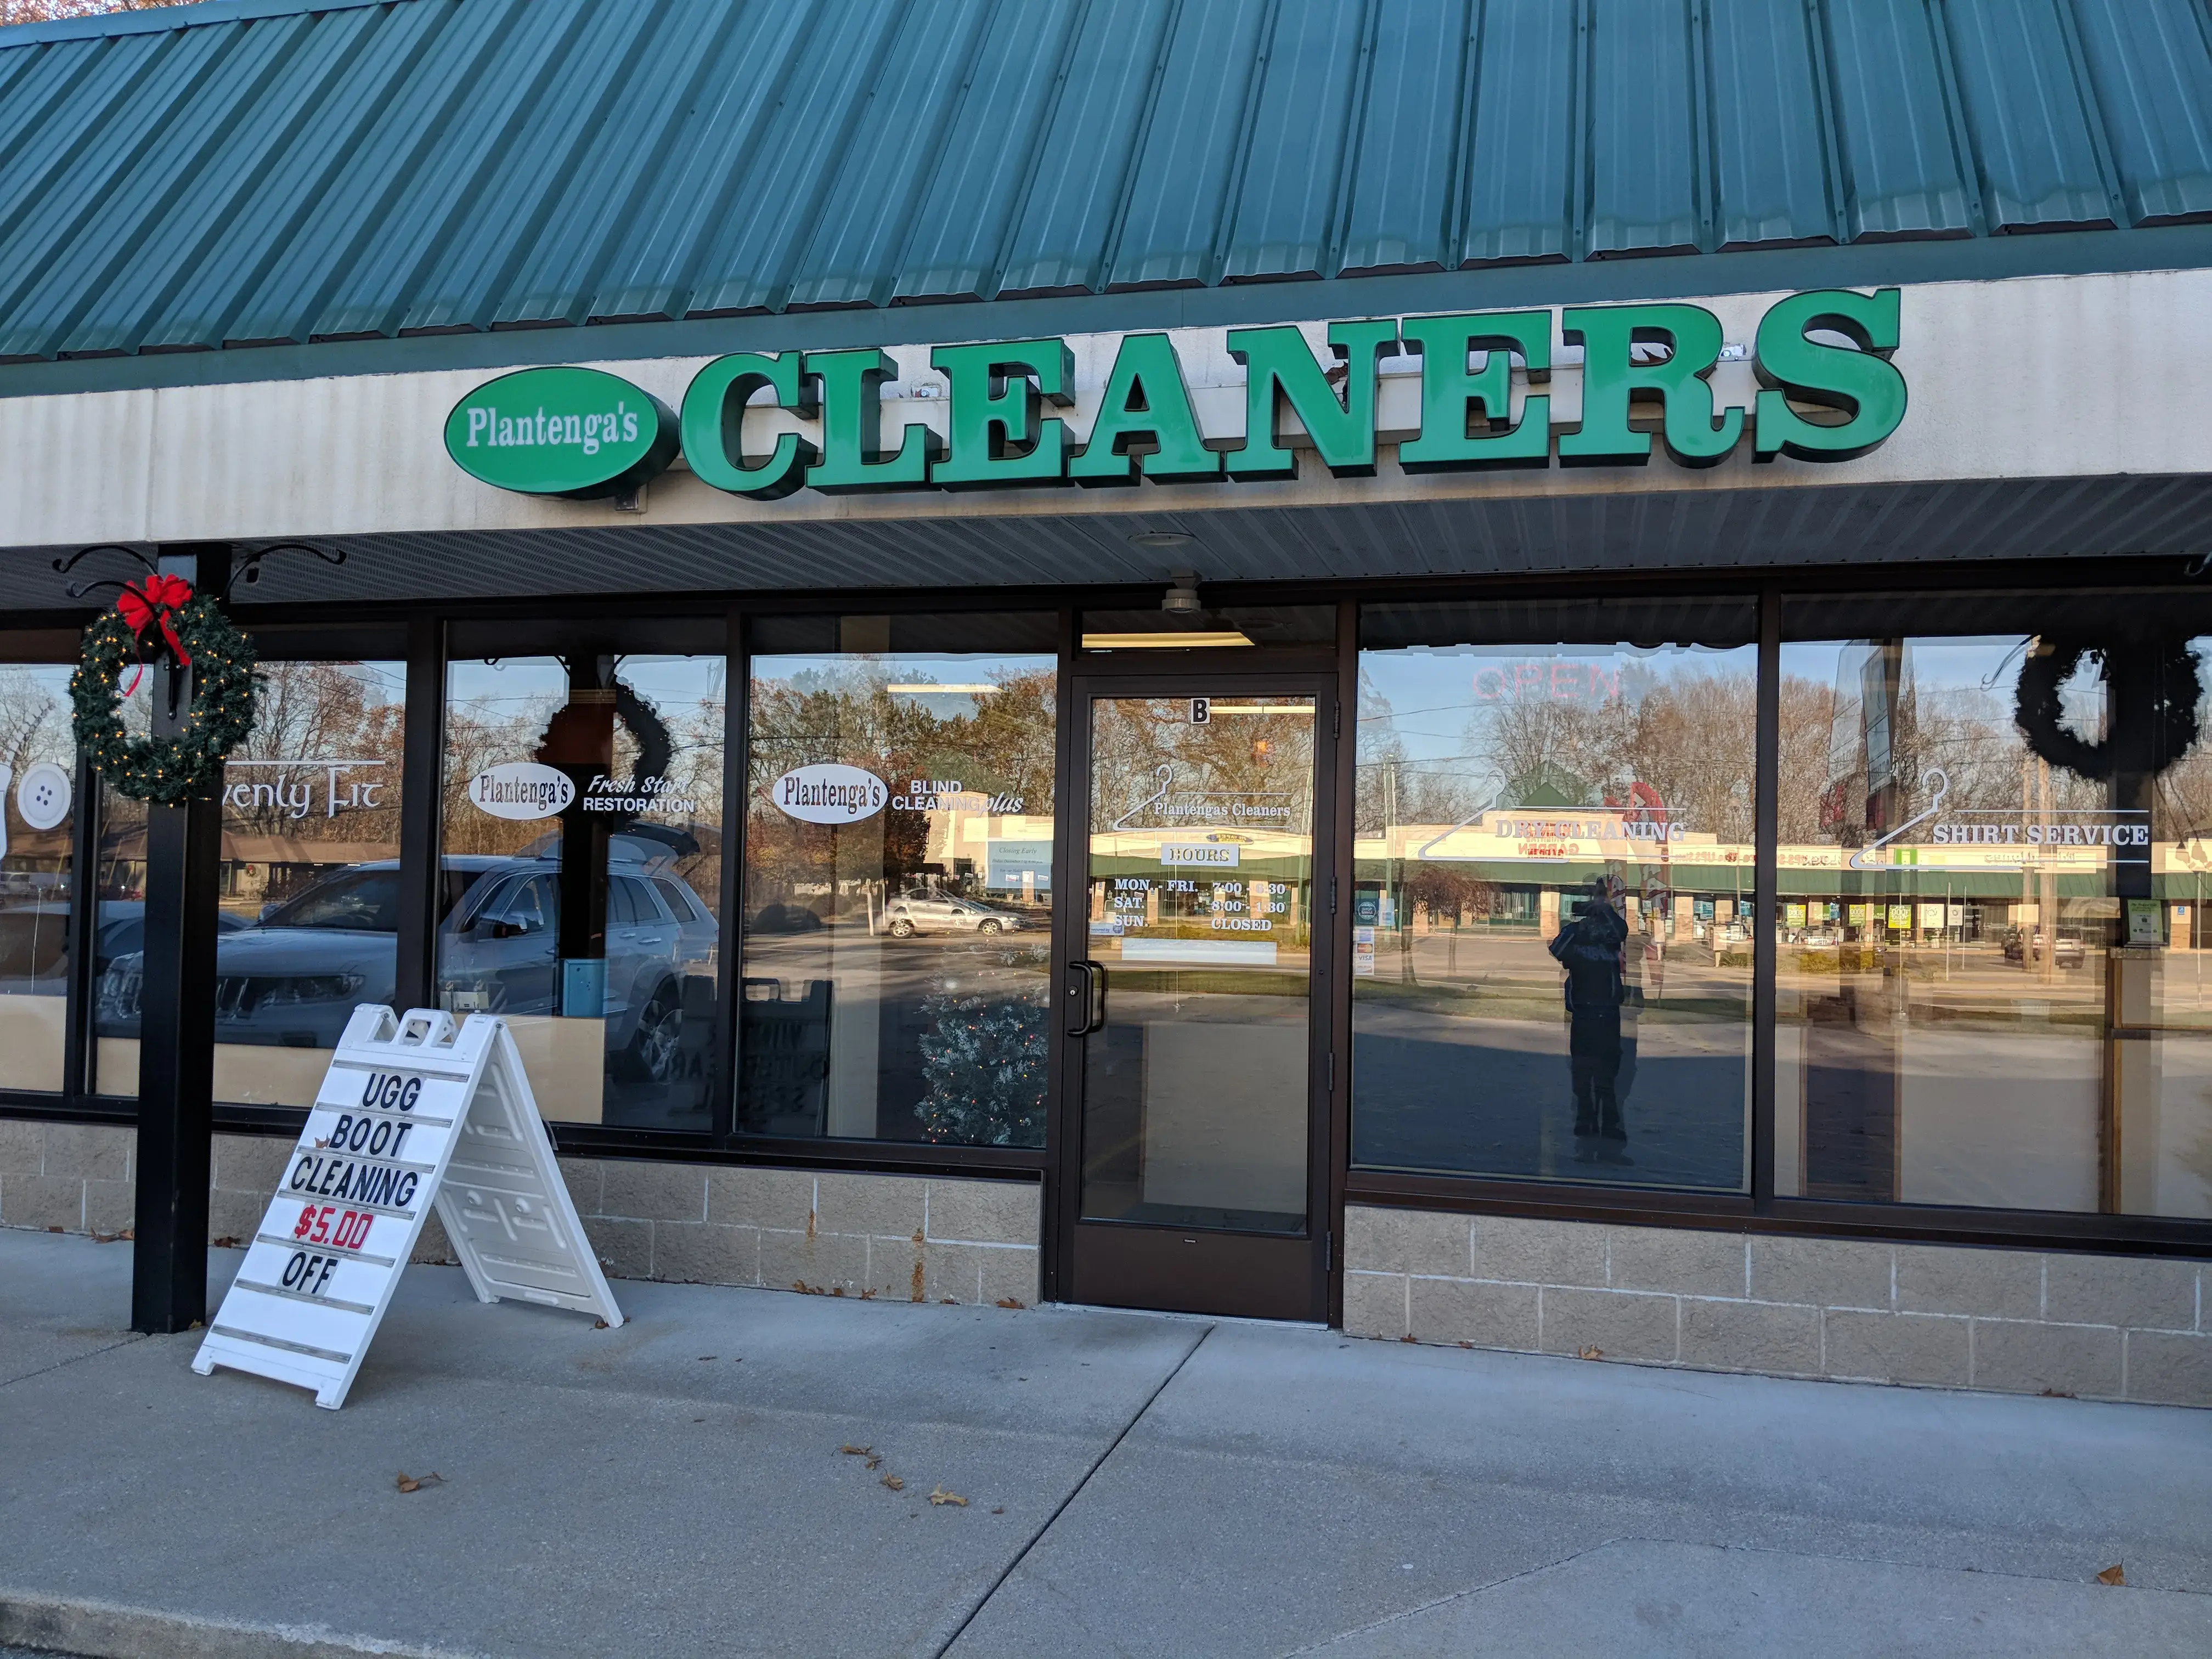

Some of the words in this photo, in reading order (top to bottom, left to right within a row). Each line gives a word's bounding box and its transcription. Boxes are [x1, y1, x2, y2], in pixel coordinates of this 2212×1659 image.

[466, 401, 637, 455] Plantenga's
[679, 287, 1908, 498] CLEANERS
[1472, 664, 1620, 699] OPEN
[1192, 699, 1208, 723] B
[328, 767, 383, 819] Fit
[479, 775, 568, 810] Plantenga's
[587, 774, 636, 793] Fresh
[641, 776, 691, 793] Start
[911, 780, 962, 794] BLIND
[583, 797, 695, 812] RESTORATION
[783, 777, 881, 815] Plantenga's
[892, 796, 980, 811] CLEANING
[977, 792, 1024, 817] plus
[1154, 802, 1228, 819] Plantengas
[1232, 803, 1290, 816] Cleaners
[1495, 820, 1544, 838] DRY
[1555, 820, 1685, 841] CLEANING
[1933, 825, 2019, 844] SHIRT
[2027, 825, 2149, 845] SERVICE
[1170, 848, 1229, 862] HOURS
[1114, 879, 1153, 890] MON.
[1167, 880, 1198, 892] FRI.
[1212, 882, 1242, 893] 7:00
[1114, 896, 1145, 909] SAT.
[1211, 901, 1242, 912] 8:00
[1256, 902, 1285, 913] 1:30
[1114, 915, 1148, 927] SUN.
[1211, 918, 1272, 931] CLOSED
[362, 1073, 421, 1111] UGG
[329, 1114, 413, 1158] BOOT
[291, 1156, 418, 1207] CLEANING
[294, 1204, 374, 1250] $5.00
[282, 1251, 338, 1295] OFF
